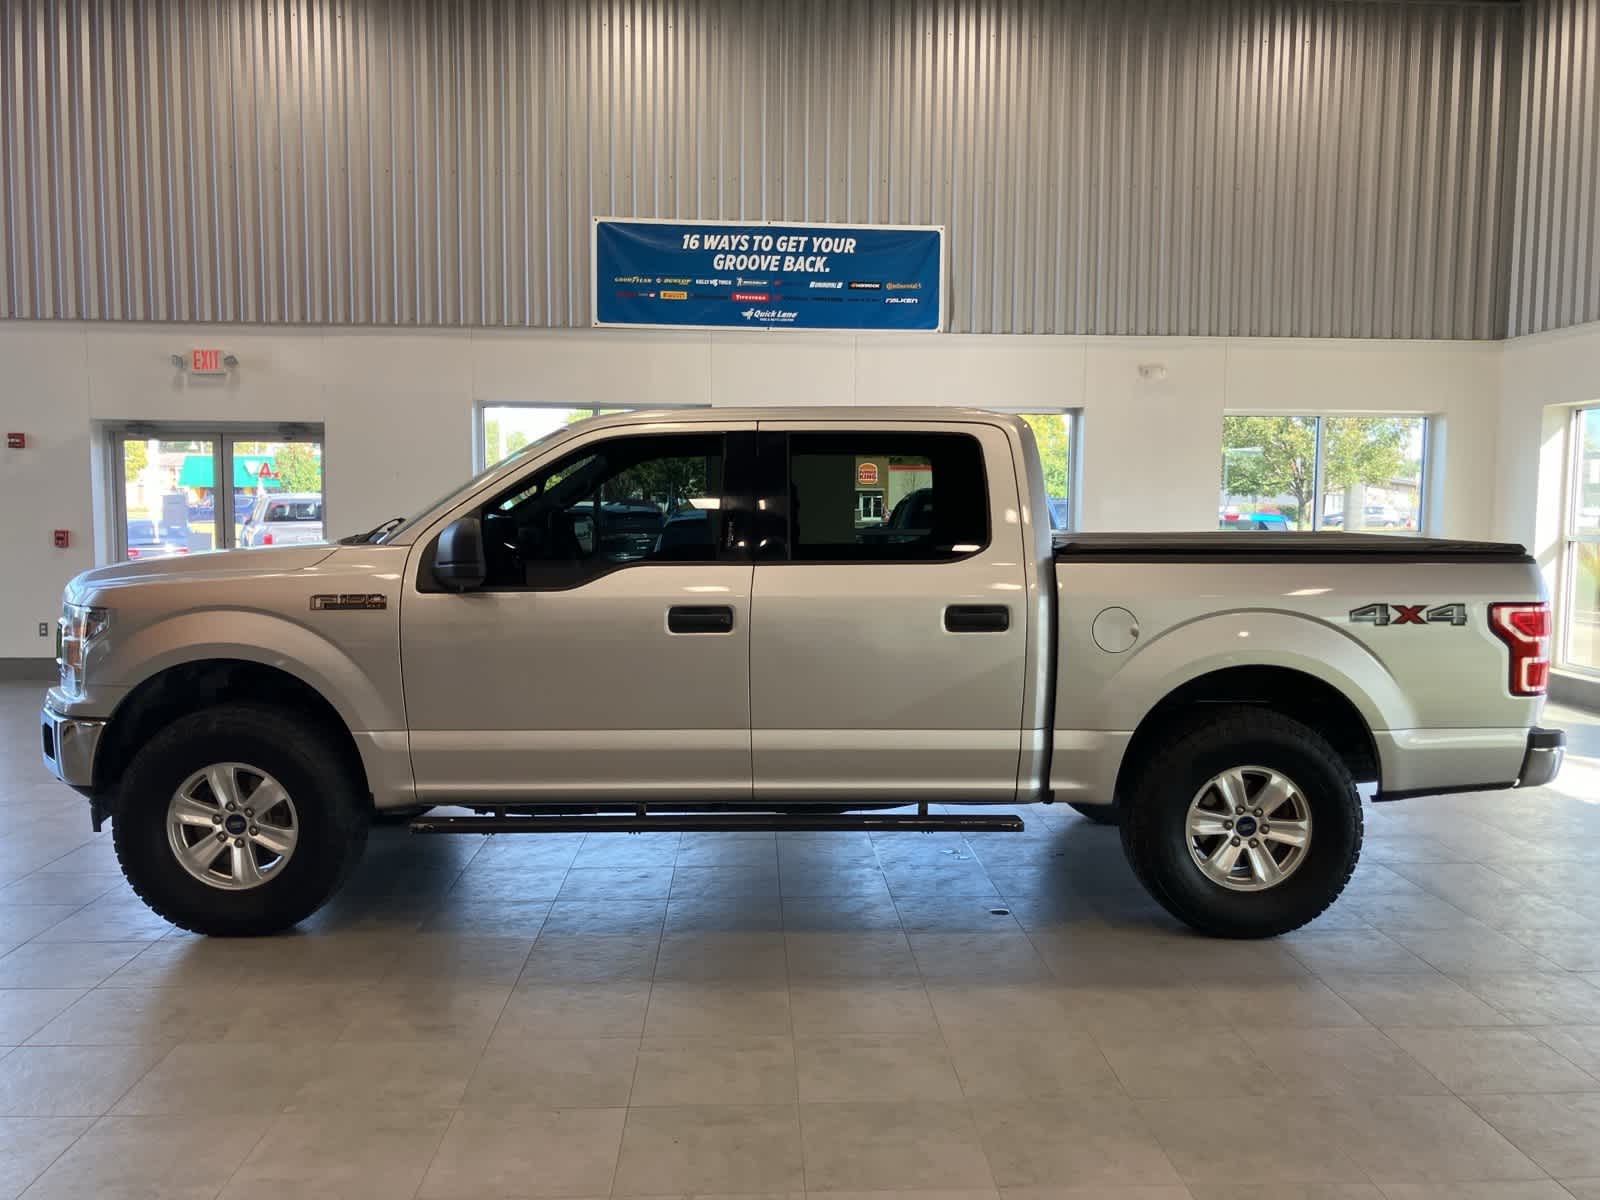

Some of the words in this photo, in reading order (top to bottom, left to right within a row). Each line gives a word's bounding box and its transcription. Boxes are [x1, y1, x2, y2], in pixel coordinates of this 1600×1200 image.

[682, 234, 700, 250] 16
[704, 234, 749, 251] WAYS
[752, 235, 774, 252] TO
[776, 236, 808, 253] GET
[812, 237, 856, 254] YOUR
[713, 254, 780, 271] GROOVE
[783, 256, 830, 273] BACK.
[754, 309, 776, 319] Quick
[777, 309, 799, 319] Lane
[193, 350, 220, 369] EXIT
